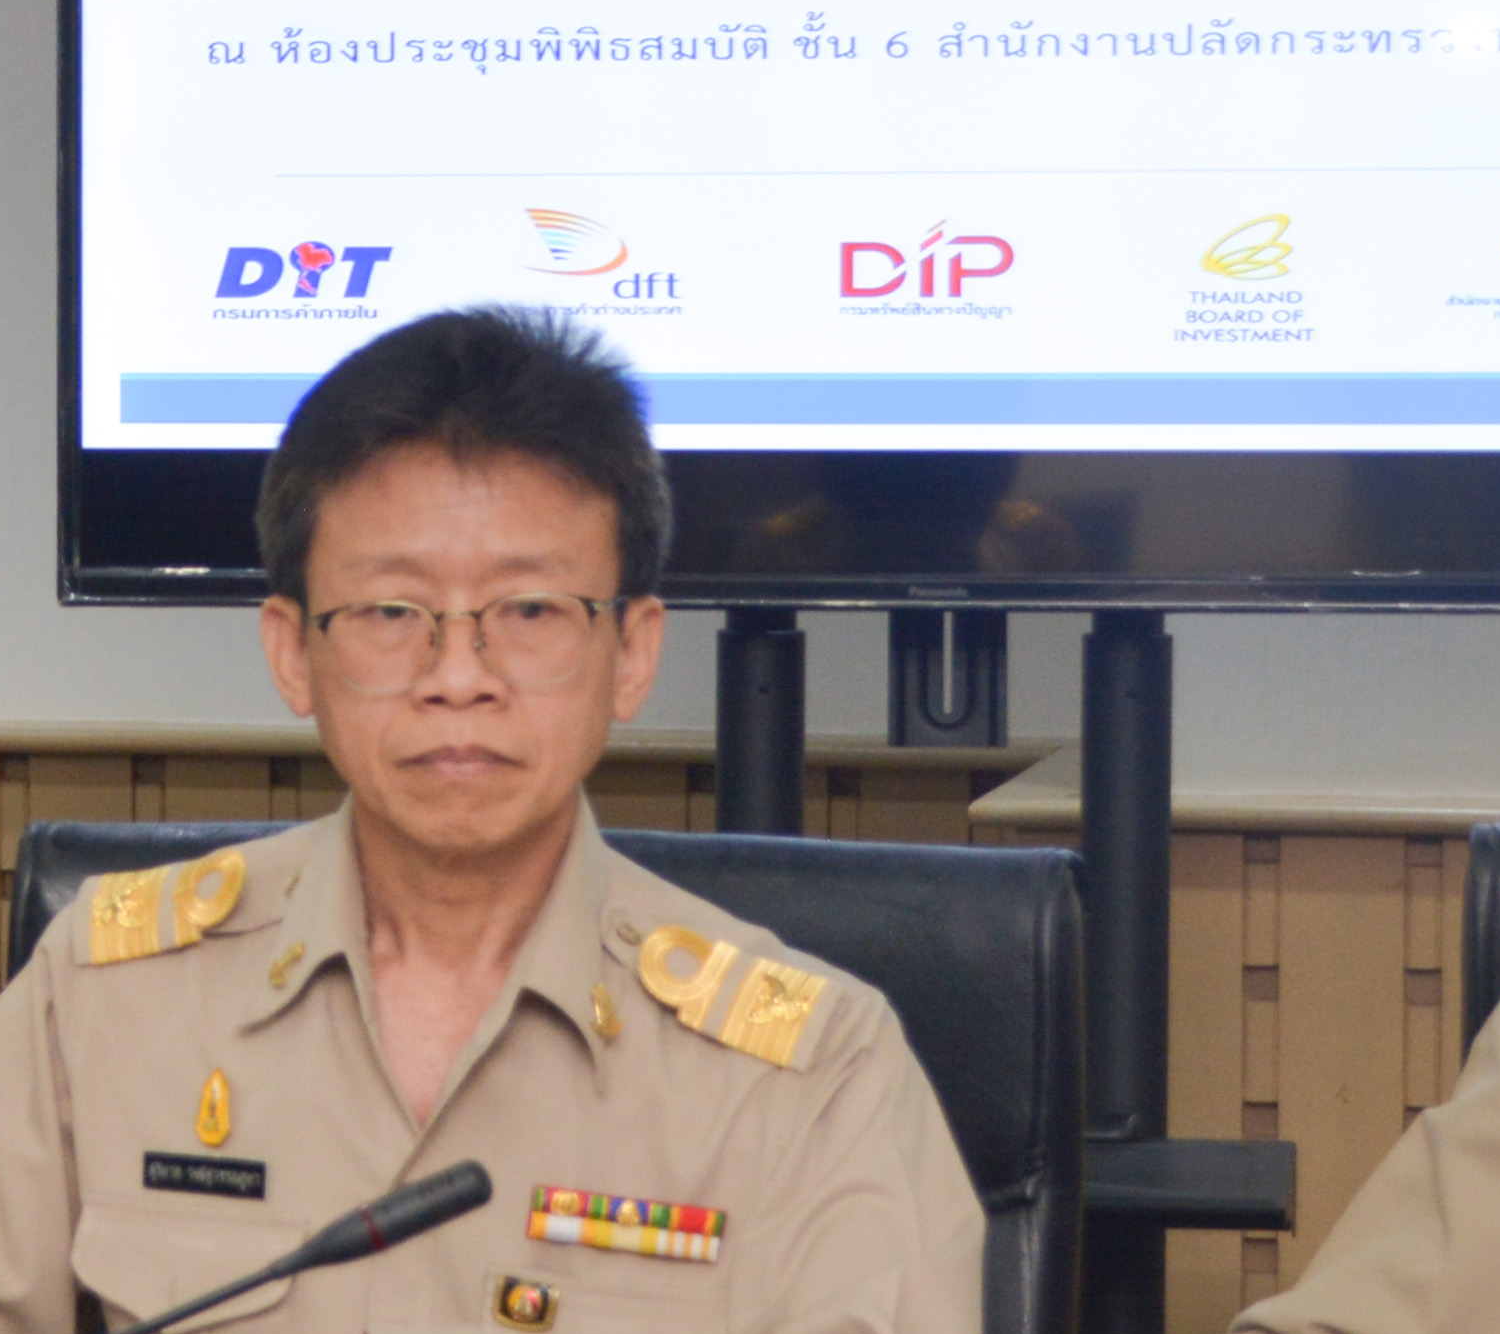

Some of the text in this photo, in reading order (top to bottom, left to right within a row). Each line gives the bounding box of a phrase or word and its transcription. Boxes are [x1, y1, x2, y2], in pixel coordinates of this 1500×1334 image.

[207, 40, 247, 65] ณ
[269, 22, 769, 75] ห้องประชุมพิพิธสมบัติ
[792, 10, 858, 61] ชั้น
[884, 30, 910, 60] 6
[214, 239, 394, 299] DIT
[612, 272, 681, 300] dft
[1188, 290, 1304, 305] THAILAND
[1185, 308, 1305, 324] BOARD OF
[1173, 327, 1316, 343] INVESTMENT
